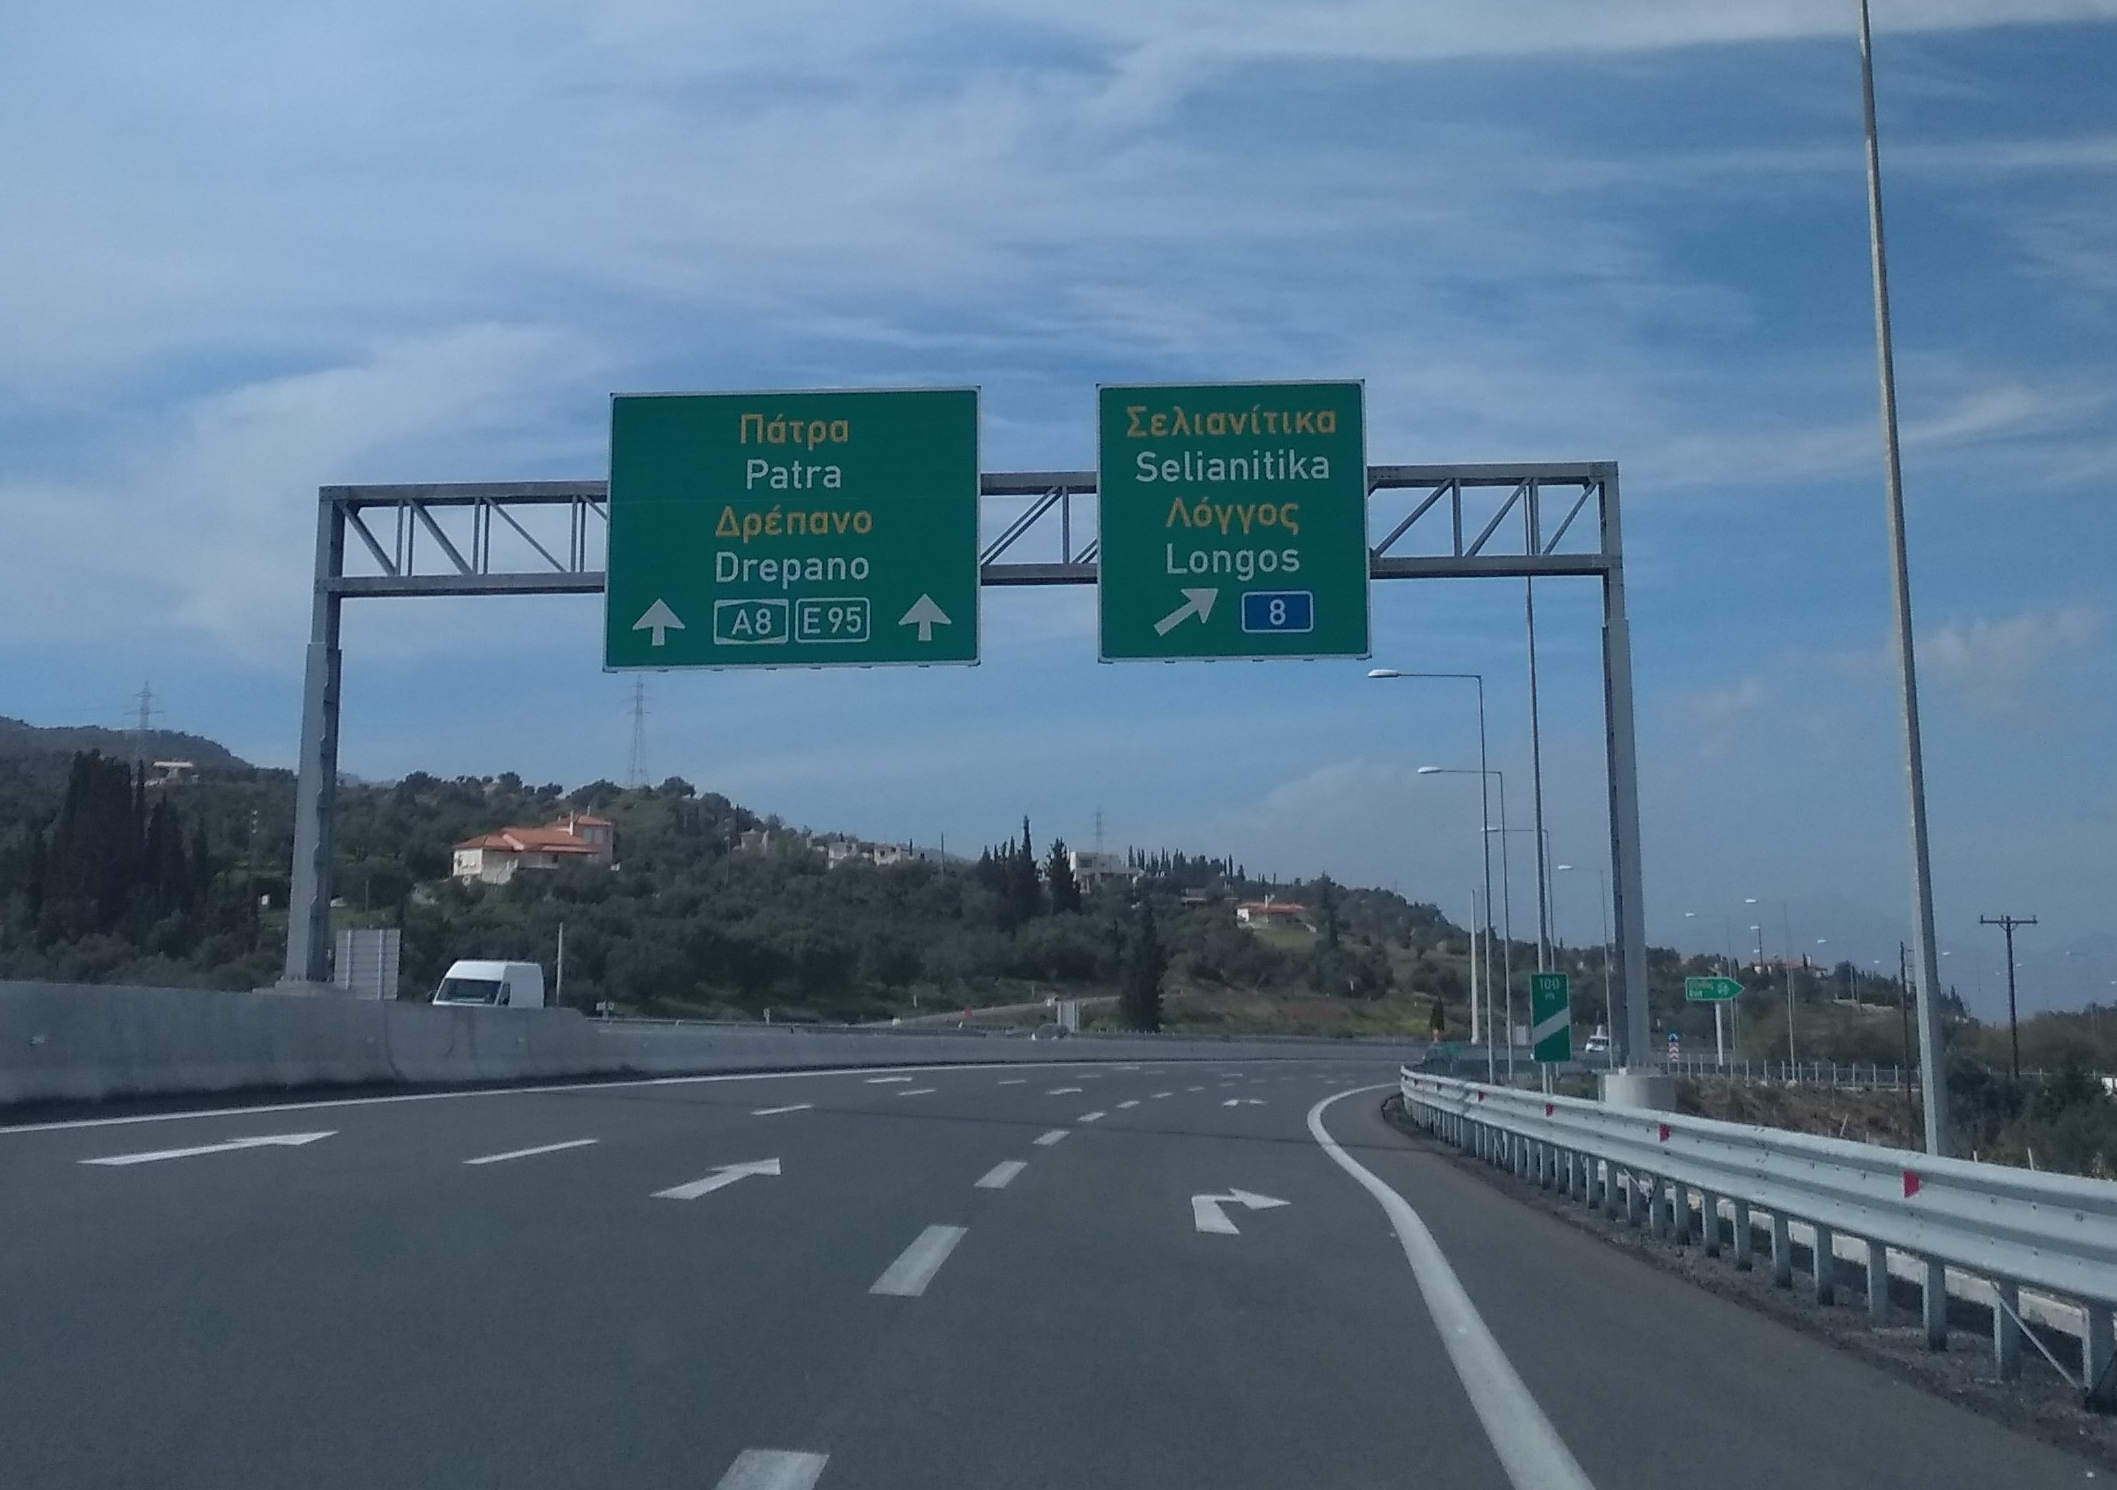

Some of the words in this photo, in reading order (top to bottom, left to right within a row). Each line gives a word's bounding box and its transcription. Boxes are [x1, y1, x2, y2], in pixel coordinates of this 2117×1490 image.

[740, 413, 850, 451] Πάτρα
[1127, 404, 1337, 437] Σελιανίτικα
[746, 458, 843, 490] Patra
[1135, 449, 1330, 482] Selianitika
[715, 505, 873, 544] Δρέπανο
[1166, 497, 1299, 536] Λόγγος
[715, 551, 870, 590] Drepano
[1166, 543, 1301, 582] Longos
[731, 608, 772, 635] A8
[1269, 599, 1287, 626] 8
[1540, 977, 1560, 990] 100
